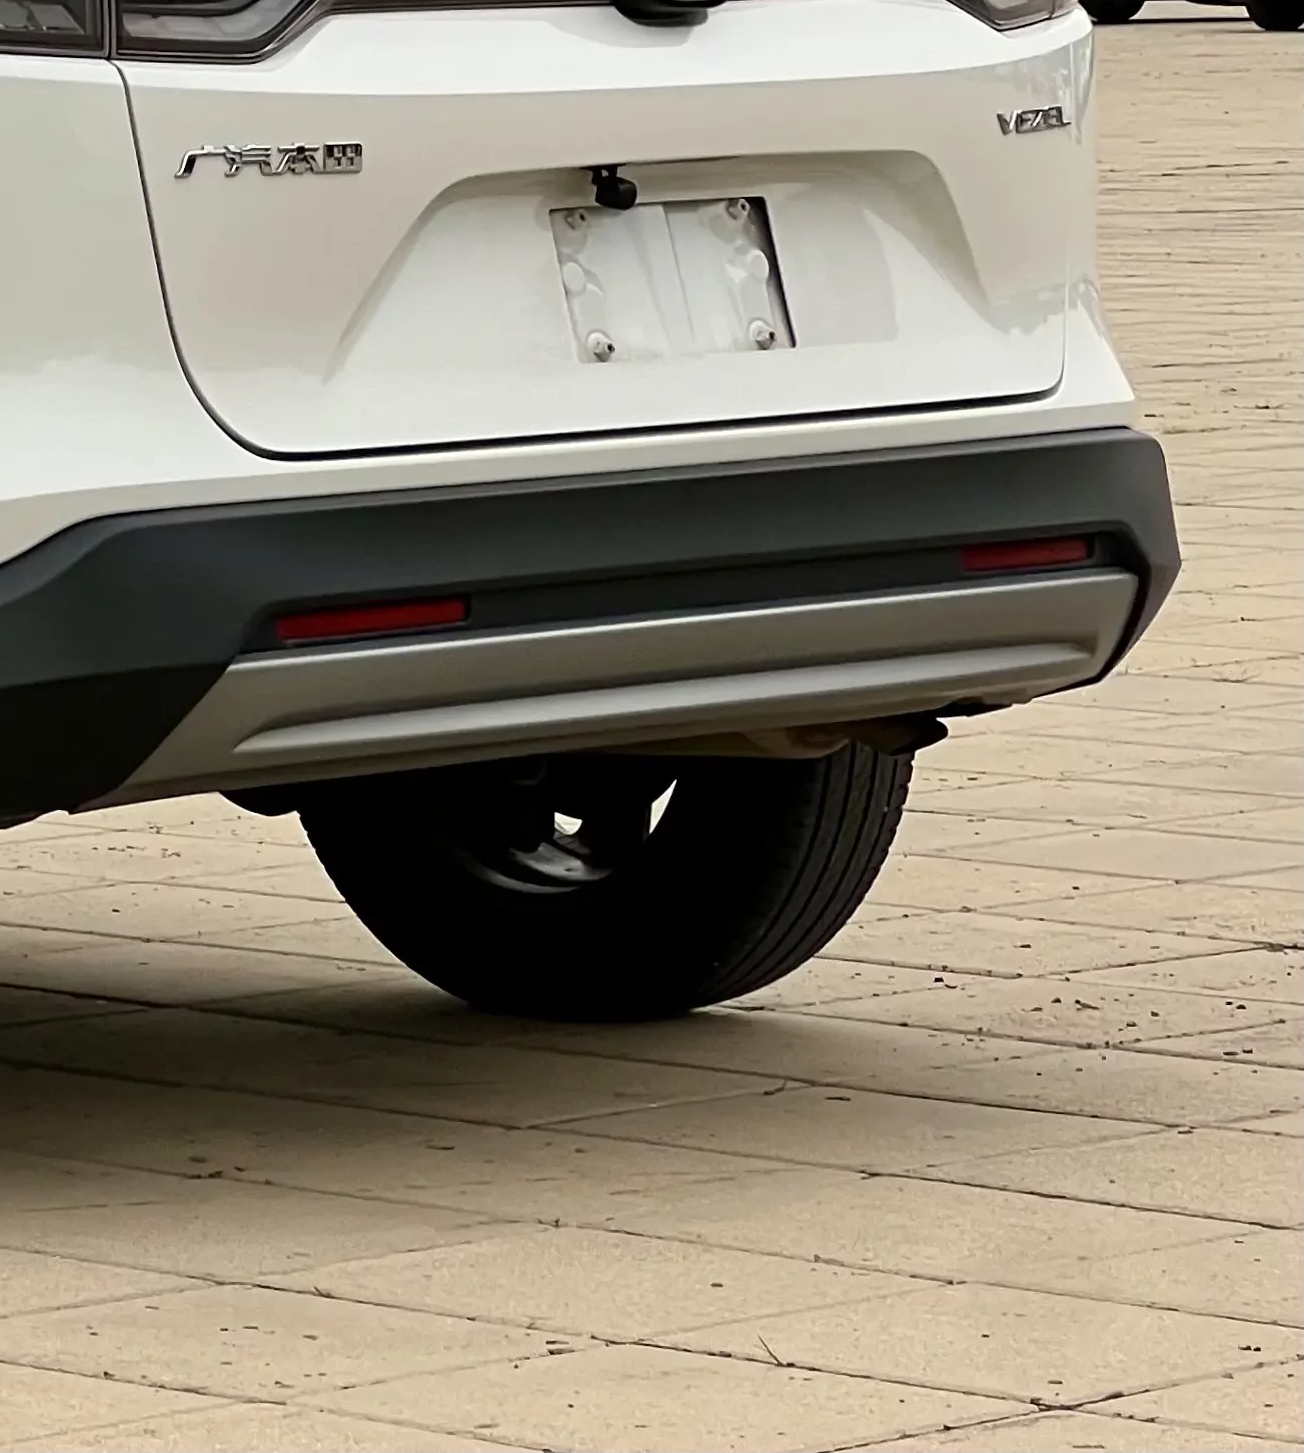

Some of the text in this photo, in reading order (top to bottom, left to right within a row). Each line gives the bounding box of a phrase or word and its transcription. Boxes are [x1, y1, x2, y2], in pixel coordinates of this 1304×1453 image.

[996, 105, 1072, 136] VEZEL
[173, 142, 363, 179] 广汽本田
